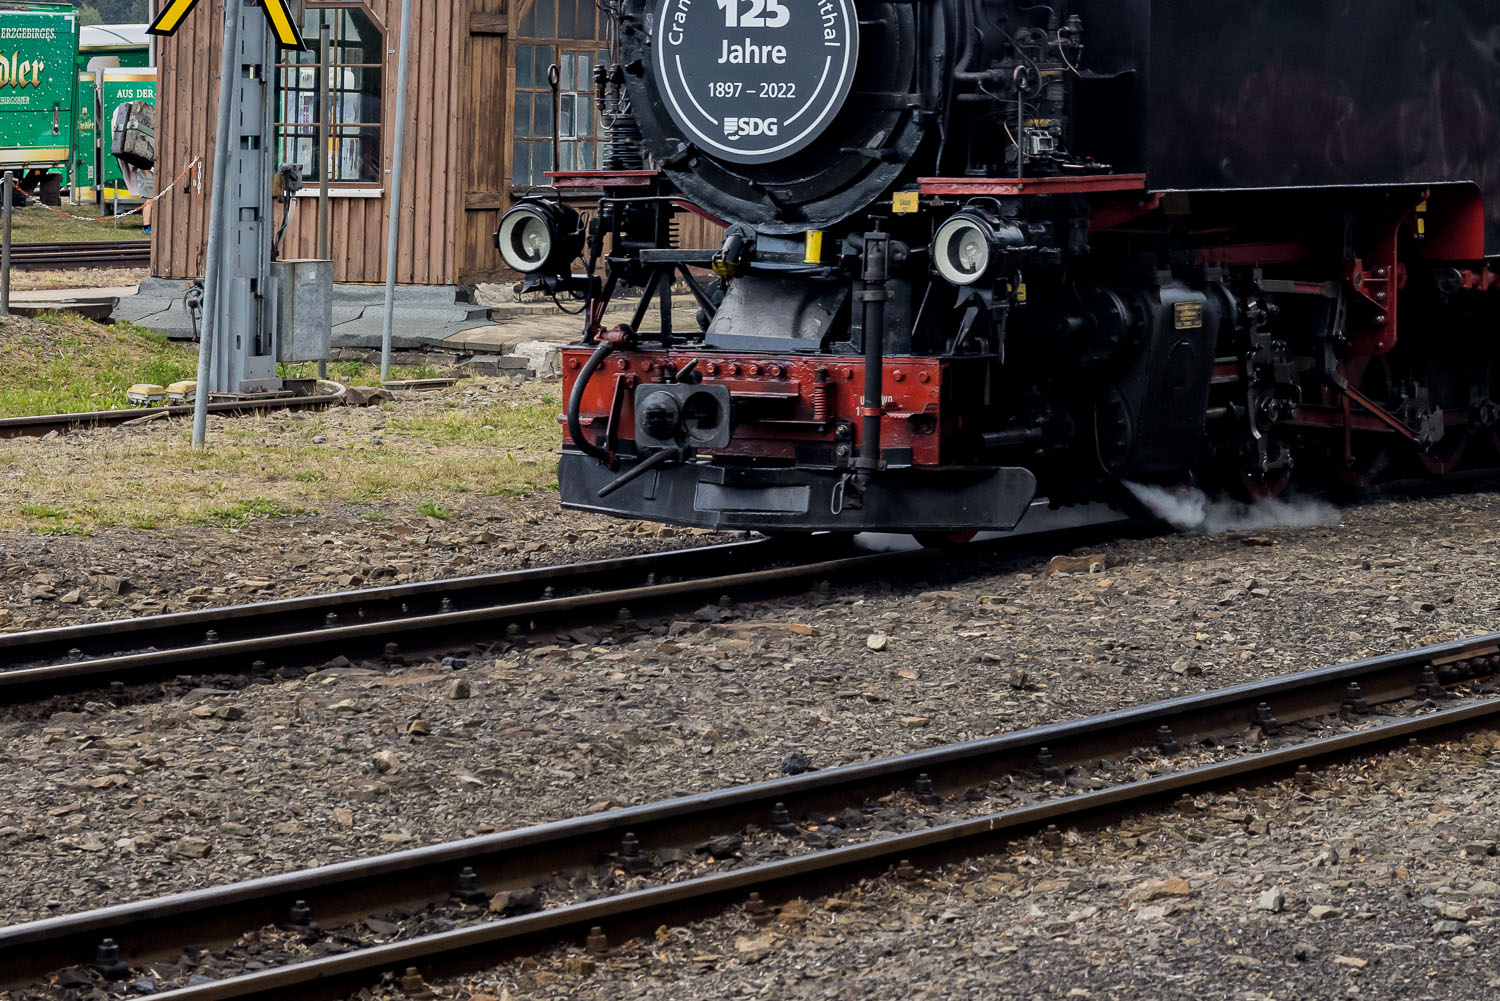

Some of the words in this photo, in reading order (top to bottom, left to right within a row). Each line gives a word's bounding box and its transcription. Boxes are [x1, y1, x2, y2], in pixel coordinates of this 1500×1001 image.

[0, 27, 57, 39] ERZGEBIRGES.
[717, 38, 787, 64] Jahre
[117, 89, 136, 98] AUS
[136, 89, 153, 98] DER
[708, 82, 743, 97] 1897
[759, 82, 796, 98] 2022
[738, 117, 778, 136] SDG
